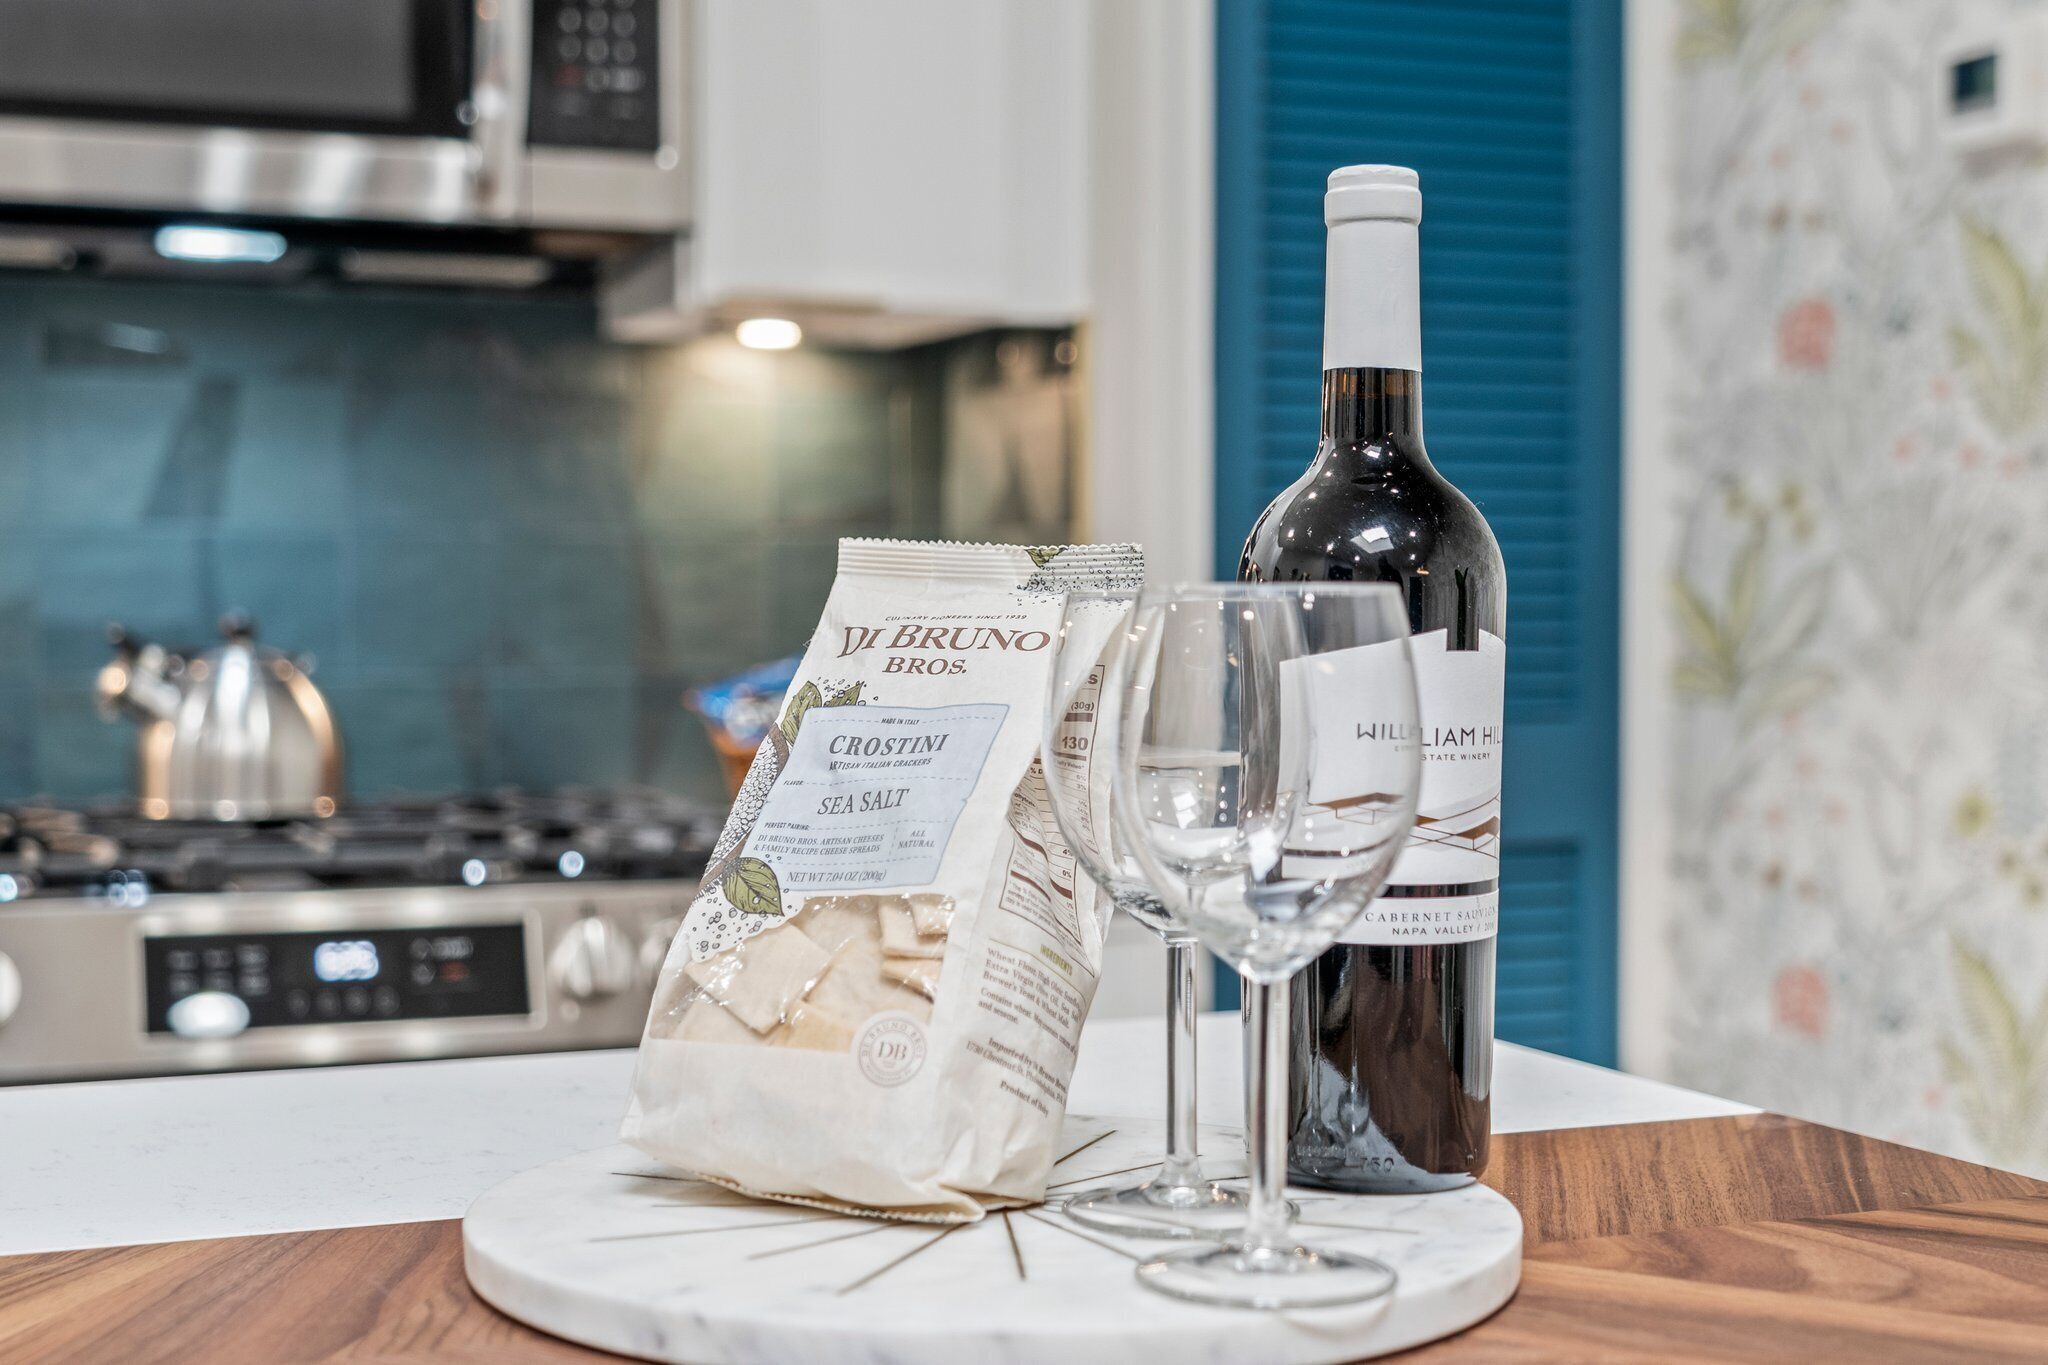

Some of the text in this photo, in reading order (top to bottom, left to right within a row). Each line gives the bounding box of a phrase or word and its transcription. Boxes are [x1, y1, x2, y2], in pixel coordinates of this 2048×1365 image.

[885, 624, 1051, 652] BRUNO
[882, 656, 968, 676] BROS.
[1070, 701, 1095, 712] (30g)
[881, 717, 896, 725] MADE
[904, 718, 920, 726] ITALY
[829, 733, 950, 757] CROSTINI
[1061, 736, 1089, 751] 130
[1460, 752, 1491, 760] WINERY
[829, 757, 933, 772] ARTISAN ITALIAN CRACKERS
[816, 788, 911, 816] SEA SALT
[764, 822, 788, 830] PERFECT
[910, 829, 926, 838] ALL
[757, 834, 885, 846] DI BRUNO BROS. ARTISAN CHEESES
[897, 839, 936, 850] NATURAL
[760, 844, 790, 854] FAMILY
[790, 845, 819, 856] RECIPE
[818, 845, 849, 856] CHEESE
[848, 843, 881, 854] SPREADS
[786, 871, 809, 883] NET
[808, 872, 824, 883] WT
[846, 872, 860, 883] OZ
[859, 869, 887, 884] (200g)
[1364, 911, 1452, 923] CABERNET
[1392, 926, 1428, 936] NAPA
[1434, 923, 1474, 936] VALLEY
[985, 958, 1009, 975] Extra
[1013, 969, 1034, 988] Virgin
[878, 1040, 908, 1062] DB
[987, 1036, 1025, 1061] Imported
[1000, 1080, 1031, 1104] Product
